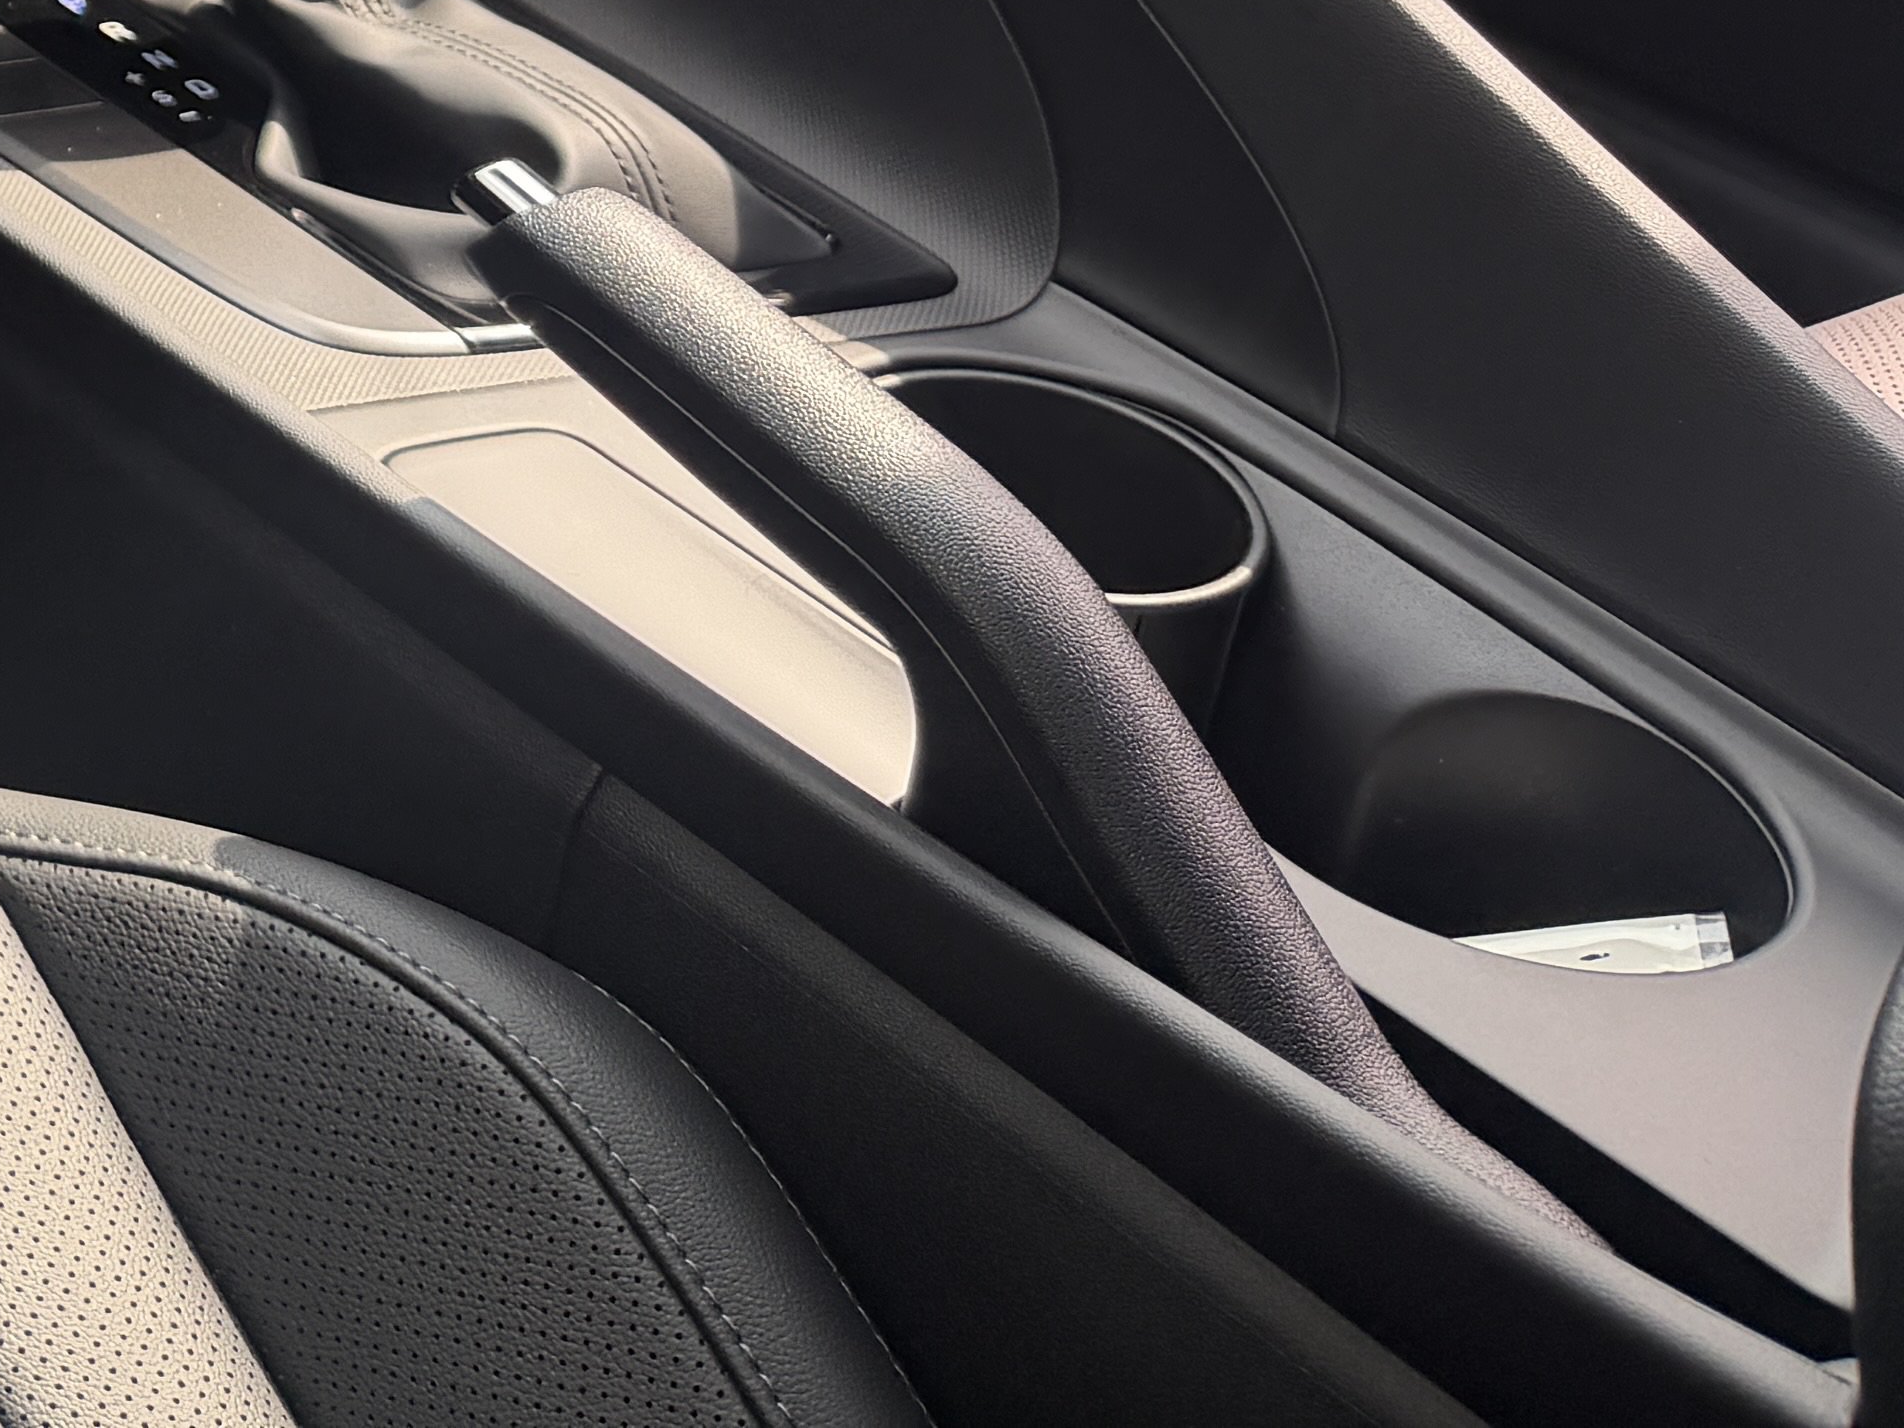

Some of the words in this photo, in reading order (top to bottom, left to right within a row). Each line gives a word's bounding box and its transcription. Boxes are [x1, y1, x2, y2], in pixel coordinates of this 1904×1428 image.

[98, 21, 137, 43] R
[141, 48, 178, 71] N
[184, 79, 219, 100] D
